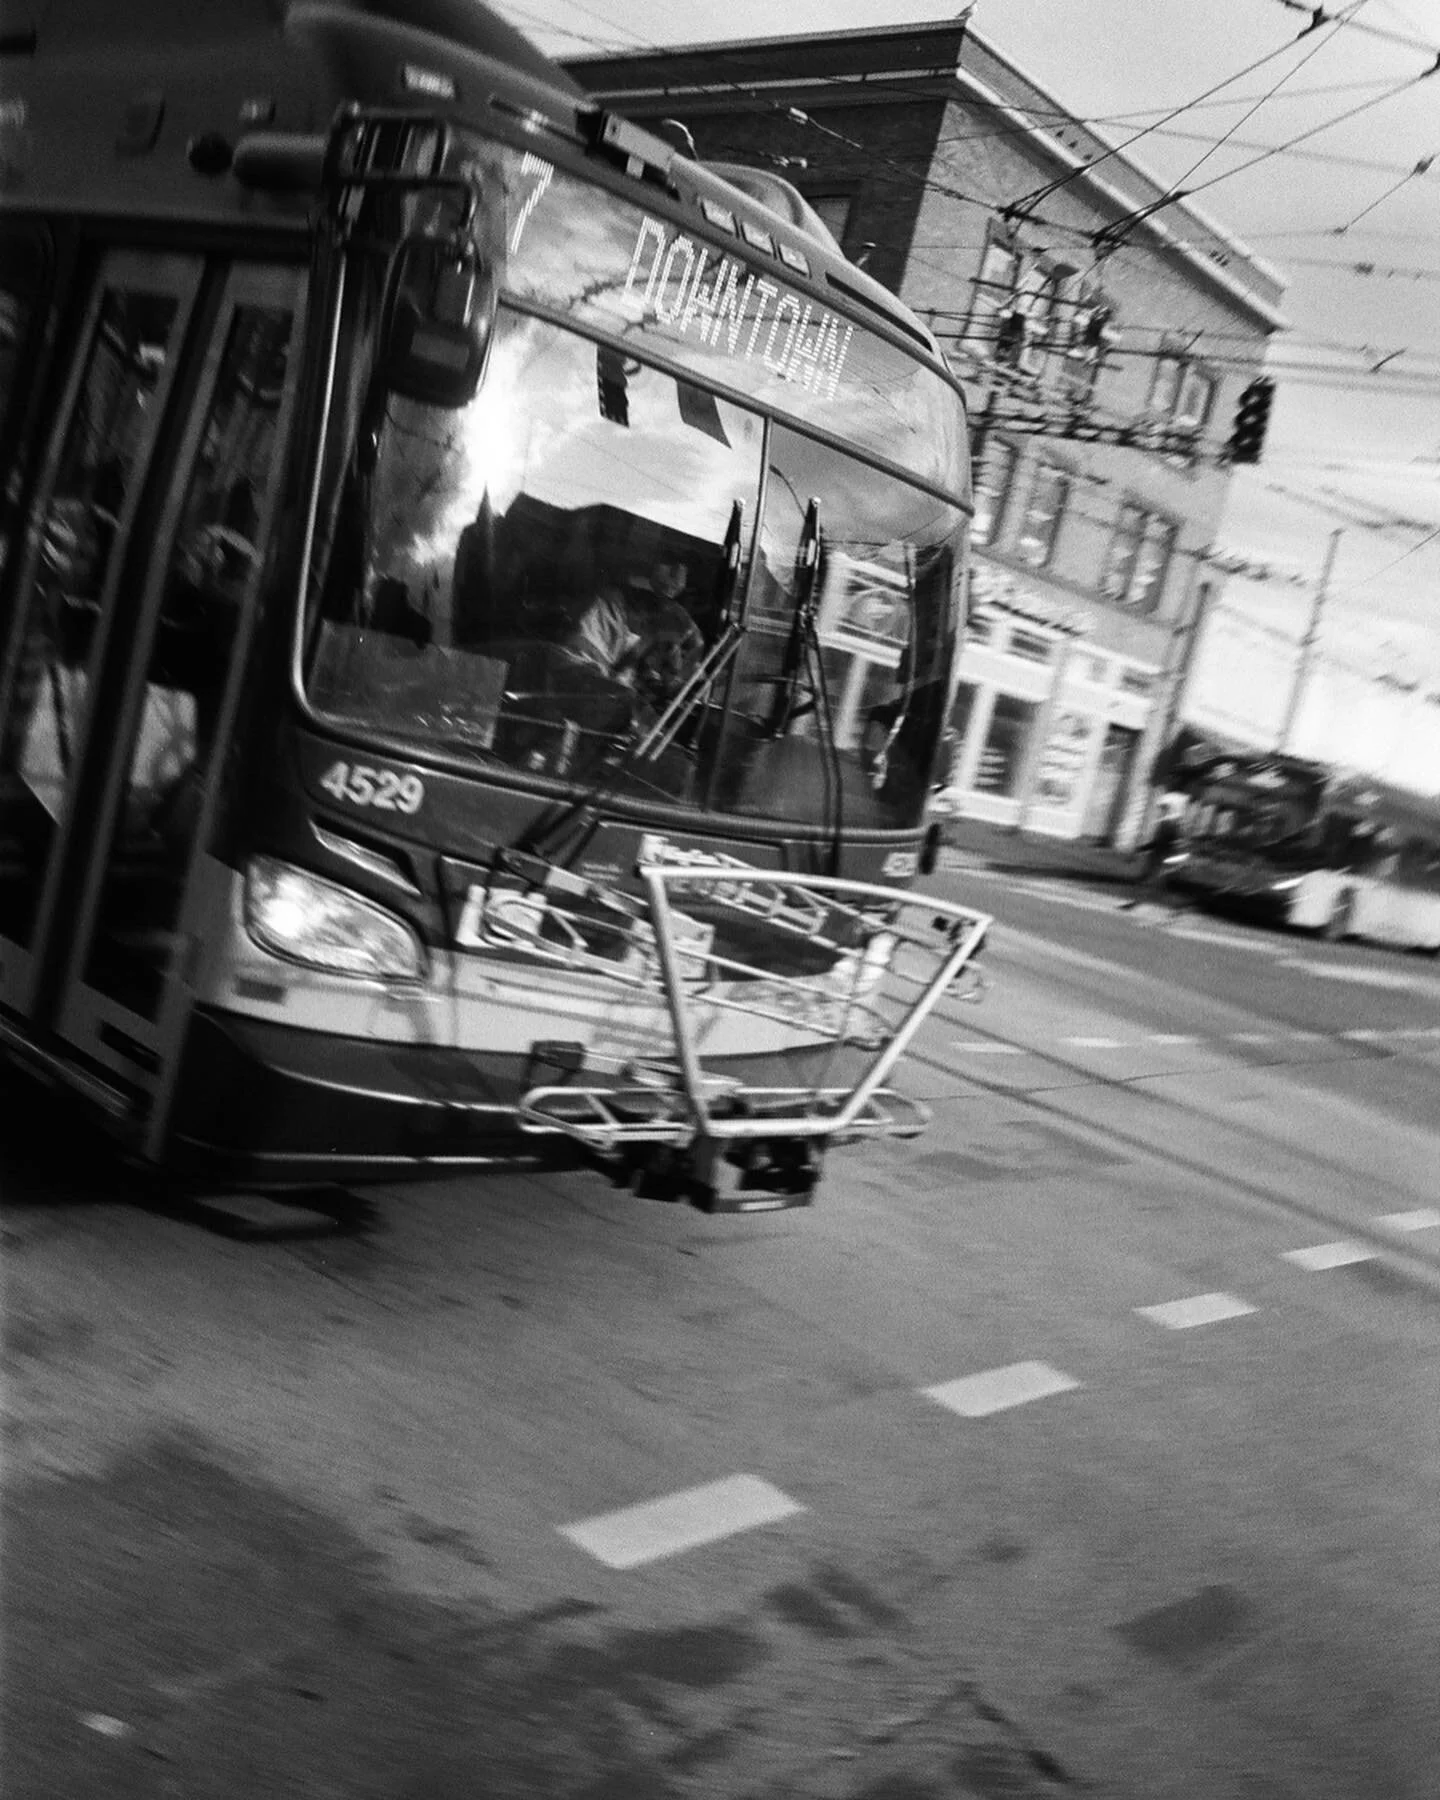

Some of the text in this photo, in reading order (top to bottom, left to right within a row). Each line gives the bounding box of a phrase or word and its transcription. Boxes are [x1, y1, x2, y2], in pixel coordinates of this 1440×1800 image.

[511, 150, 854, 402] 7 DOWNTOWN
[320, 761, 425, 815] 4529
